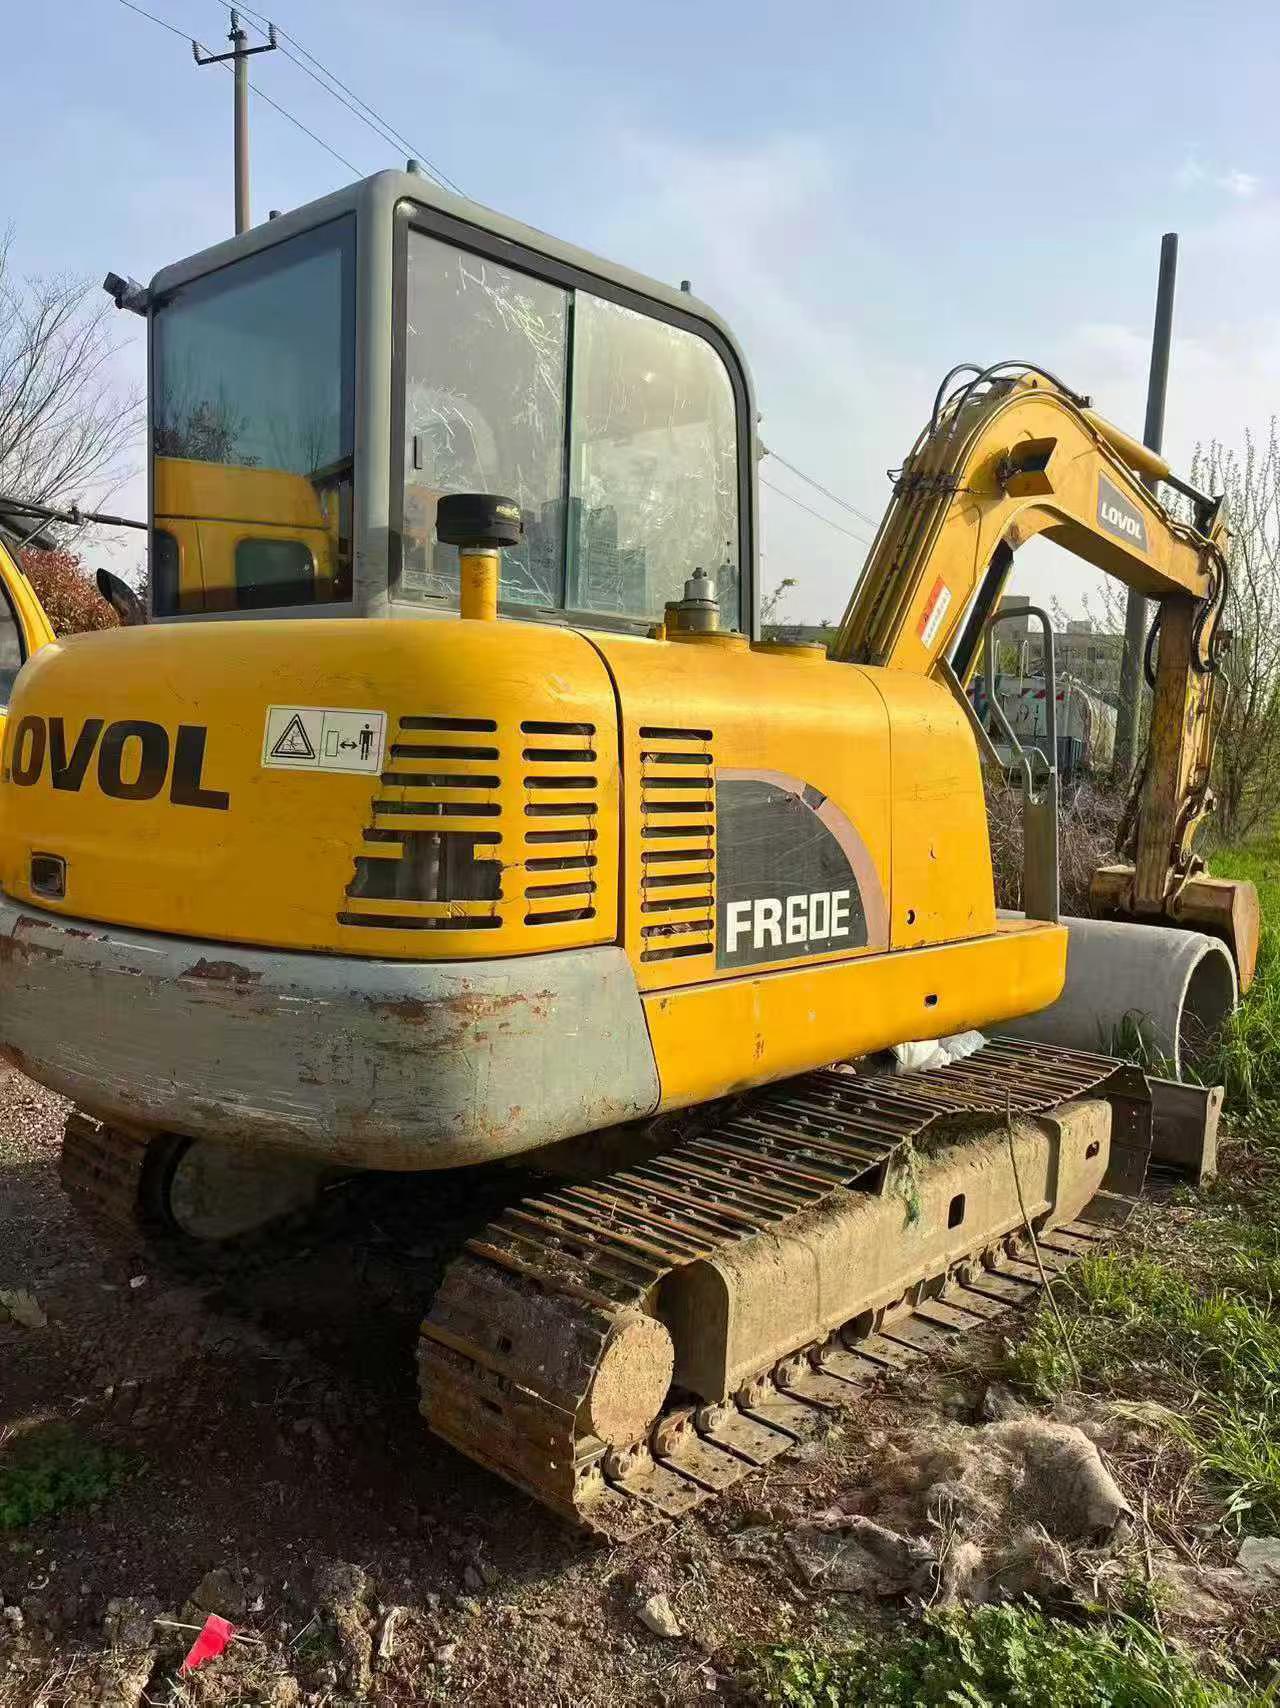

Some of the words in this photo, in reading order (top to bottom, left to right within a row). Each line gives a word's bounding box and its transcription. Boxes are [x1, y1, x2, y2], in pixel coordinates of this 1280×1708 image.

[1101, 502, 1142, 539] LOVOL
[3, 715, 230, 811] OVOL
[726, 890, 850, 952] FR60E
